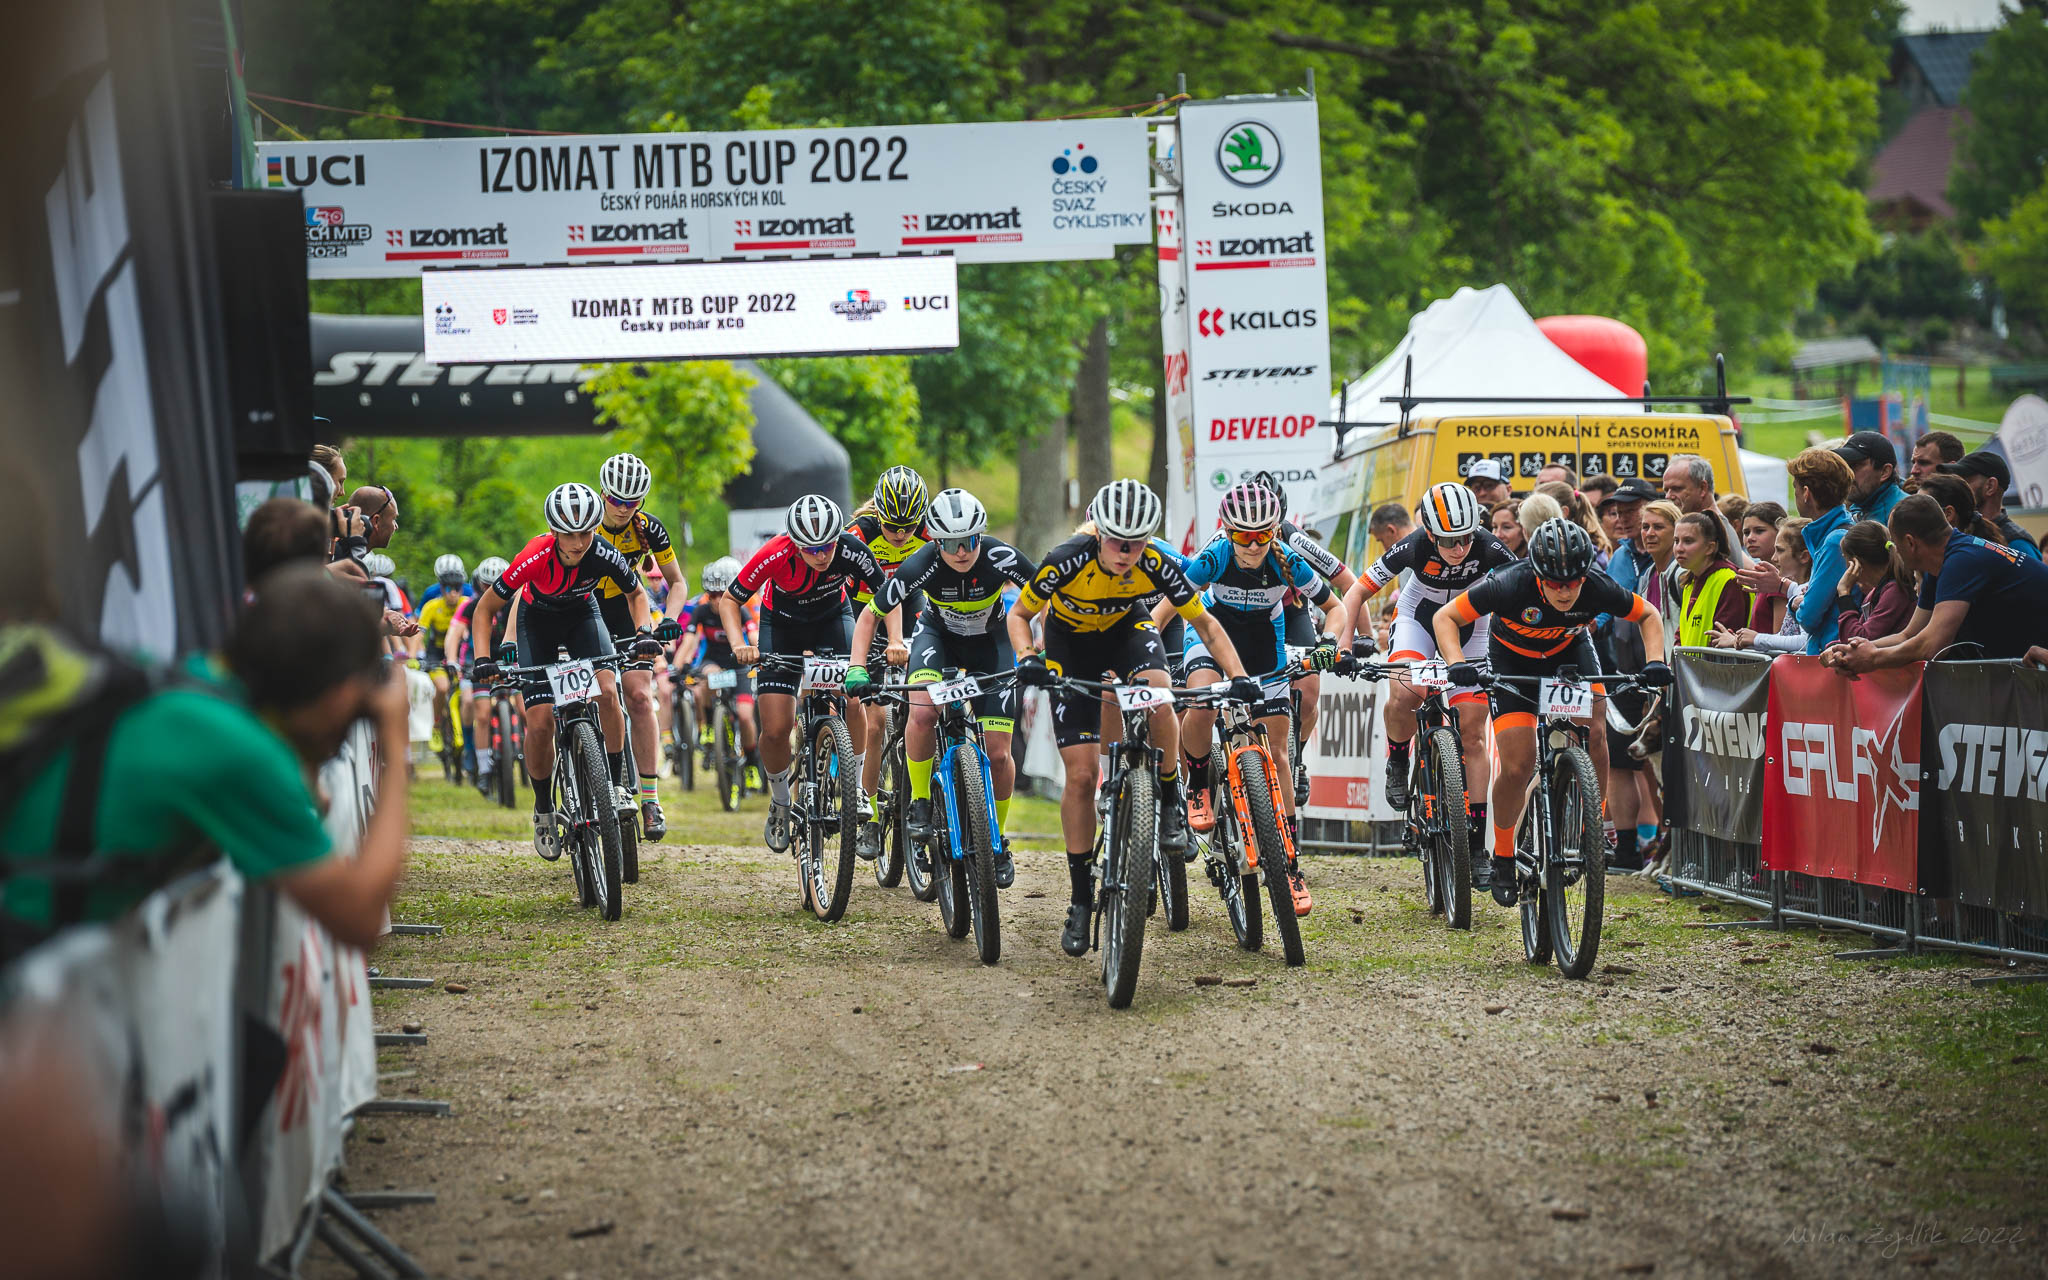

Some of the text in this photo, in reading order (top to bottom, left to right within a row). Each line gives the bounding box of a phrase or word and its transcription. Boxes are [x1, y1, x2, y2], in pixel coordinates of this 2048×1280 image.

[284, 153, 366, 188] UCI
[479, 135, 909, 193] IZOMAT MTB CUP 2022
[1051, 175, 1108, 195] ČESKÝ
[600, 188, 787, 211] ČESKÝ POHÁR HORSKÝCH KOL
[1052, 197, 1096, 212] SVAZ
[1212, 200, 1294, 218] ŠKODA
[591, 217, 688, 242] izomat
[758, 212, 855, 237] izomat
[926, 206, 1022, 231] izomat
[1052, 212, 1146, 230] CYKLISTIKY
[333, 225, 371, 241] MTB
[410, 222, 508, 247] izomat
[1219, 230, 1314, 257] izomat
[572, 293, 797, 318] IZOMAT MTB CUP 2022
[913, 295, 949, 310] UCI
[1202, 365, 1318, 381] STEVENS
[1209, 414, 1316, 442] DEVELOP
[1456, 421, 1700, 439] PROFESIONÁLNÍ ČASOMÍRA
[1606, 440, 1700, 449] SPORTOVNÍCH AKCÍ
[509, 546, 551, 582] INTERGAS
[595, 541, 629, 577] brilon
[747, 548, 788, 583] INTERGAS
[841, 544, 875, 577] brilon
[1063, 598, 1133, 615] ROUV
[553, 668, 592, 696] 709
[808, 664, 845, 684] 708
[1122, 689, 1152, 705] 70
[1545, 684, 1588, 706] 707
[1550, 704, 1581, 714] DEVELOP
[1937, 723, 2048, 804] STEVE
